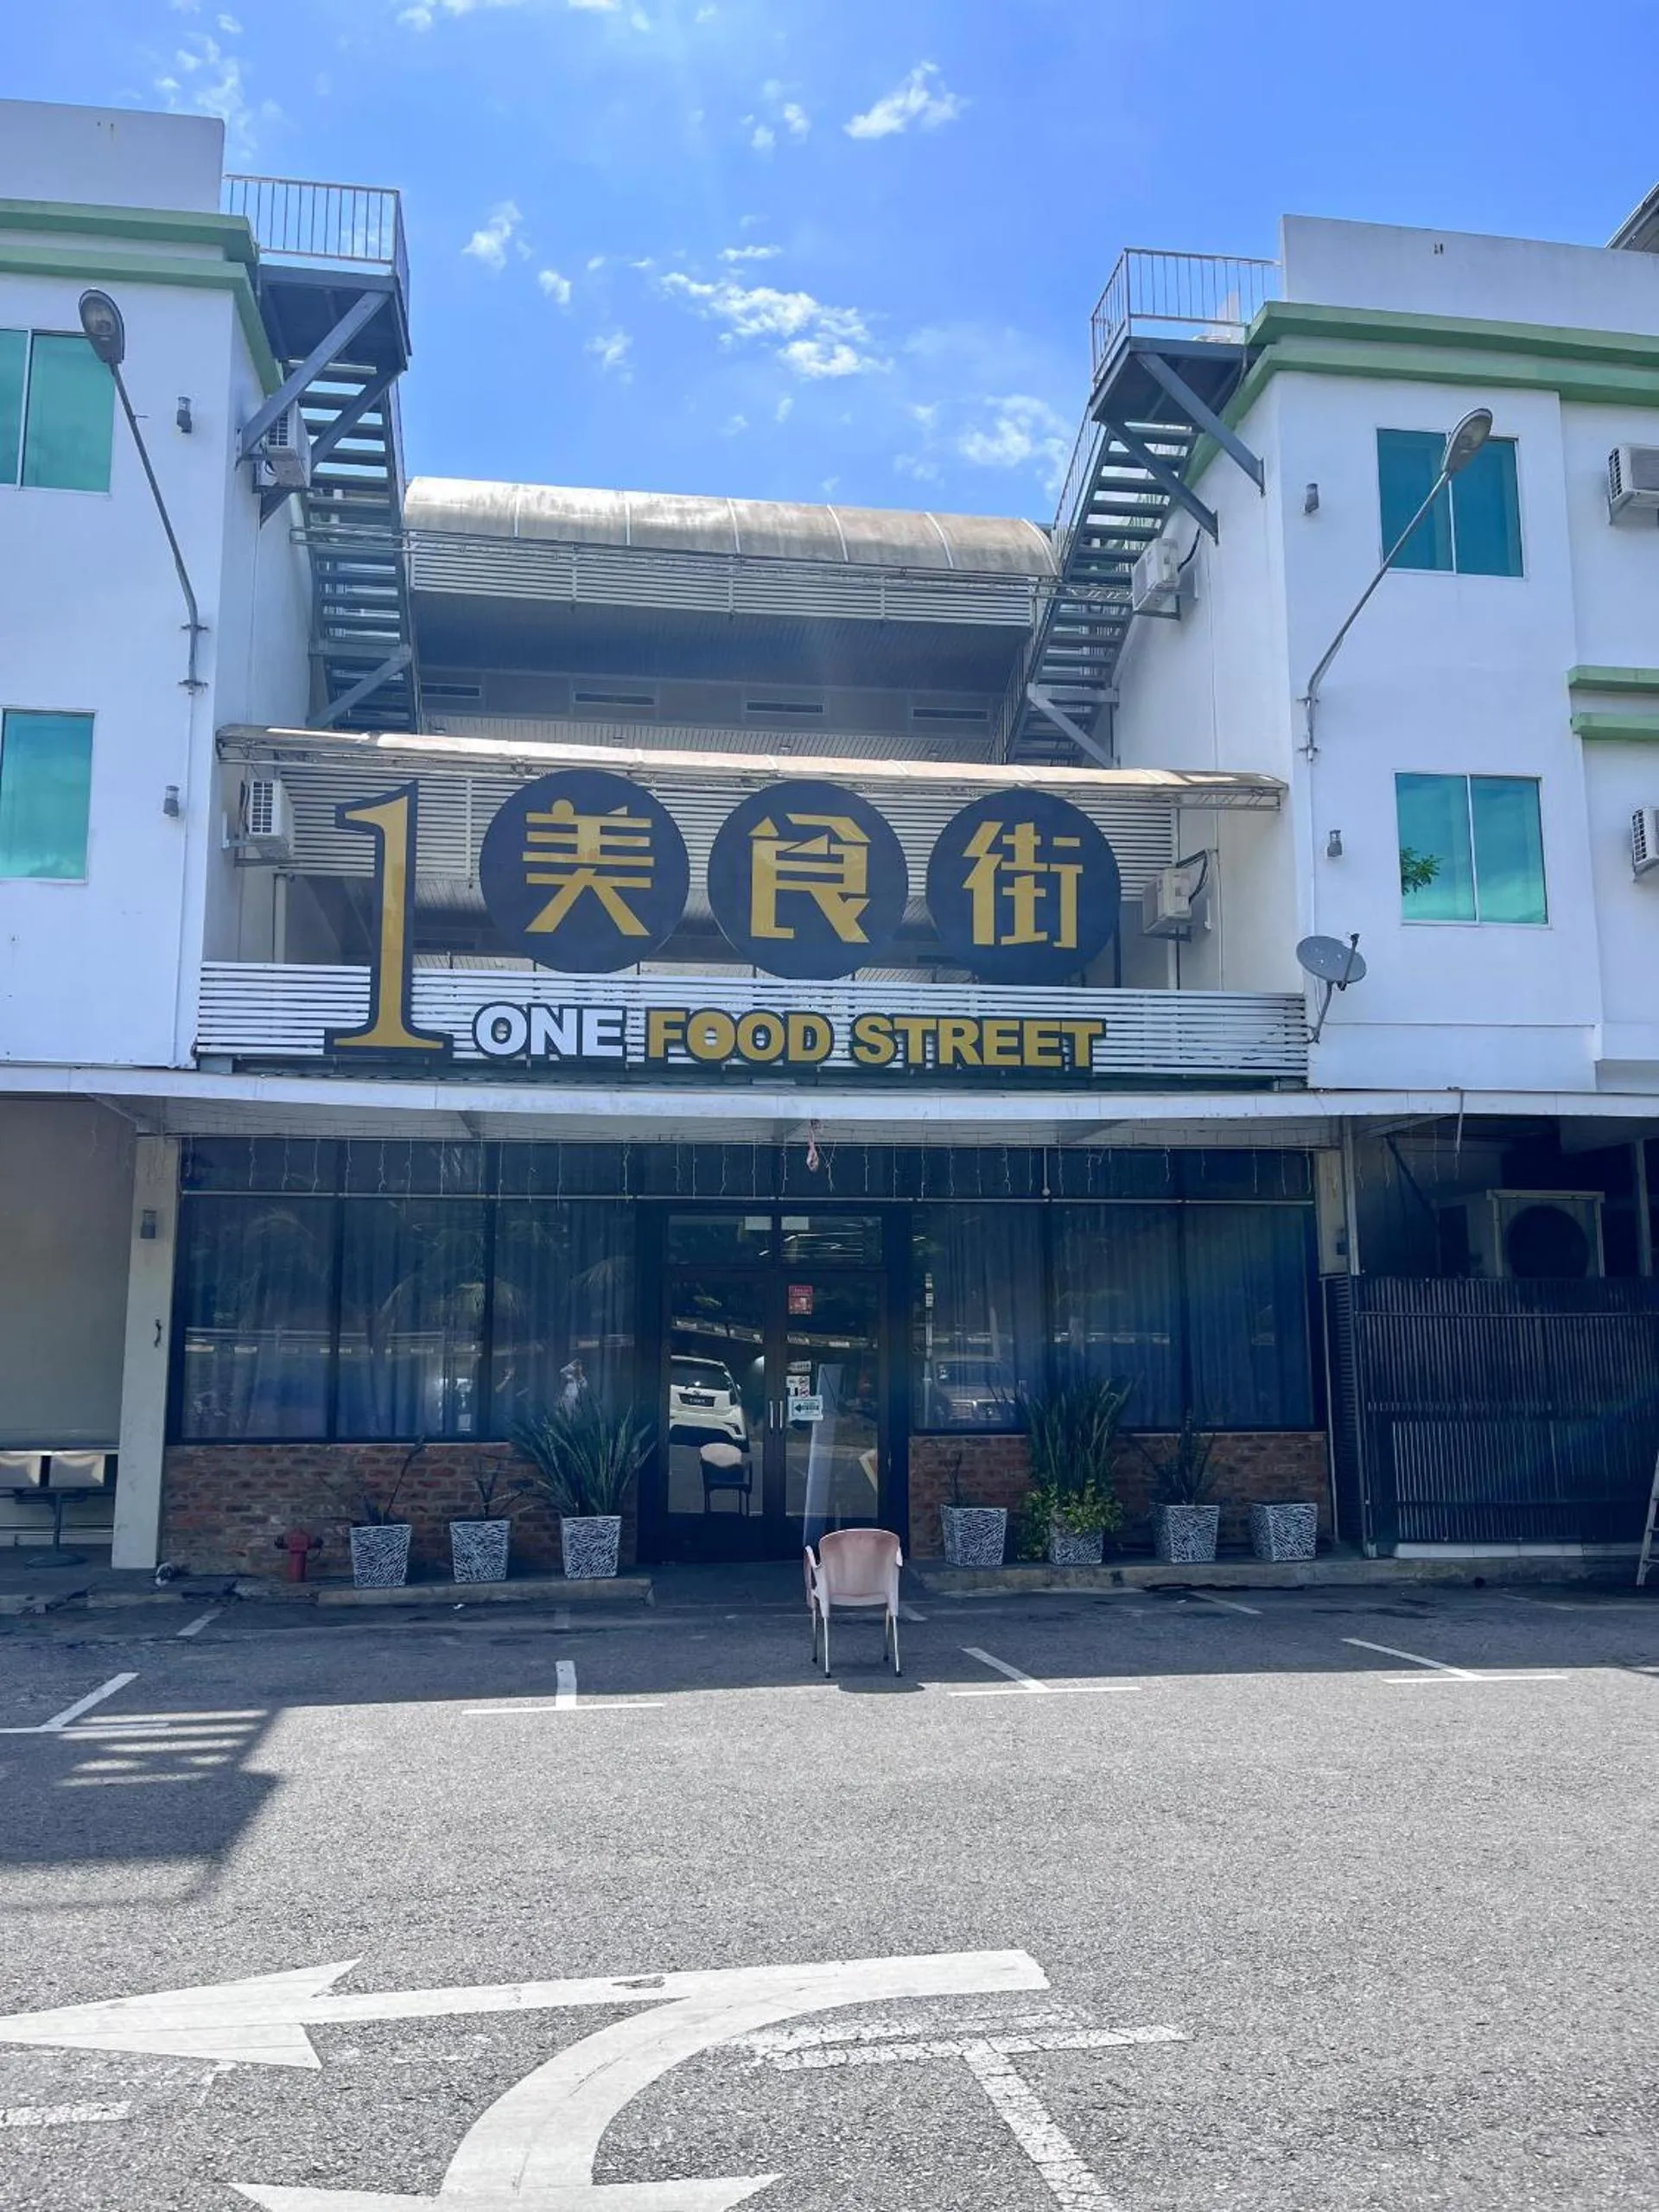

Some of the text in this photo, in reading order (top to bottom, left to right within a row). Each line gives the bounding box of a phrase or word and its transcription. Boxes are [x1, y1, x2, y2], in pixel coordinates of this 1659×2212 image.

[332, 793, 446, 1050] 1
[523, 798, 1084, 949] 美食街
[474, 1003, 1104, 1068] ONE FOOD STREET
